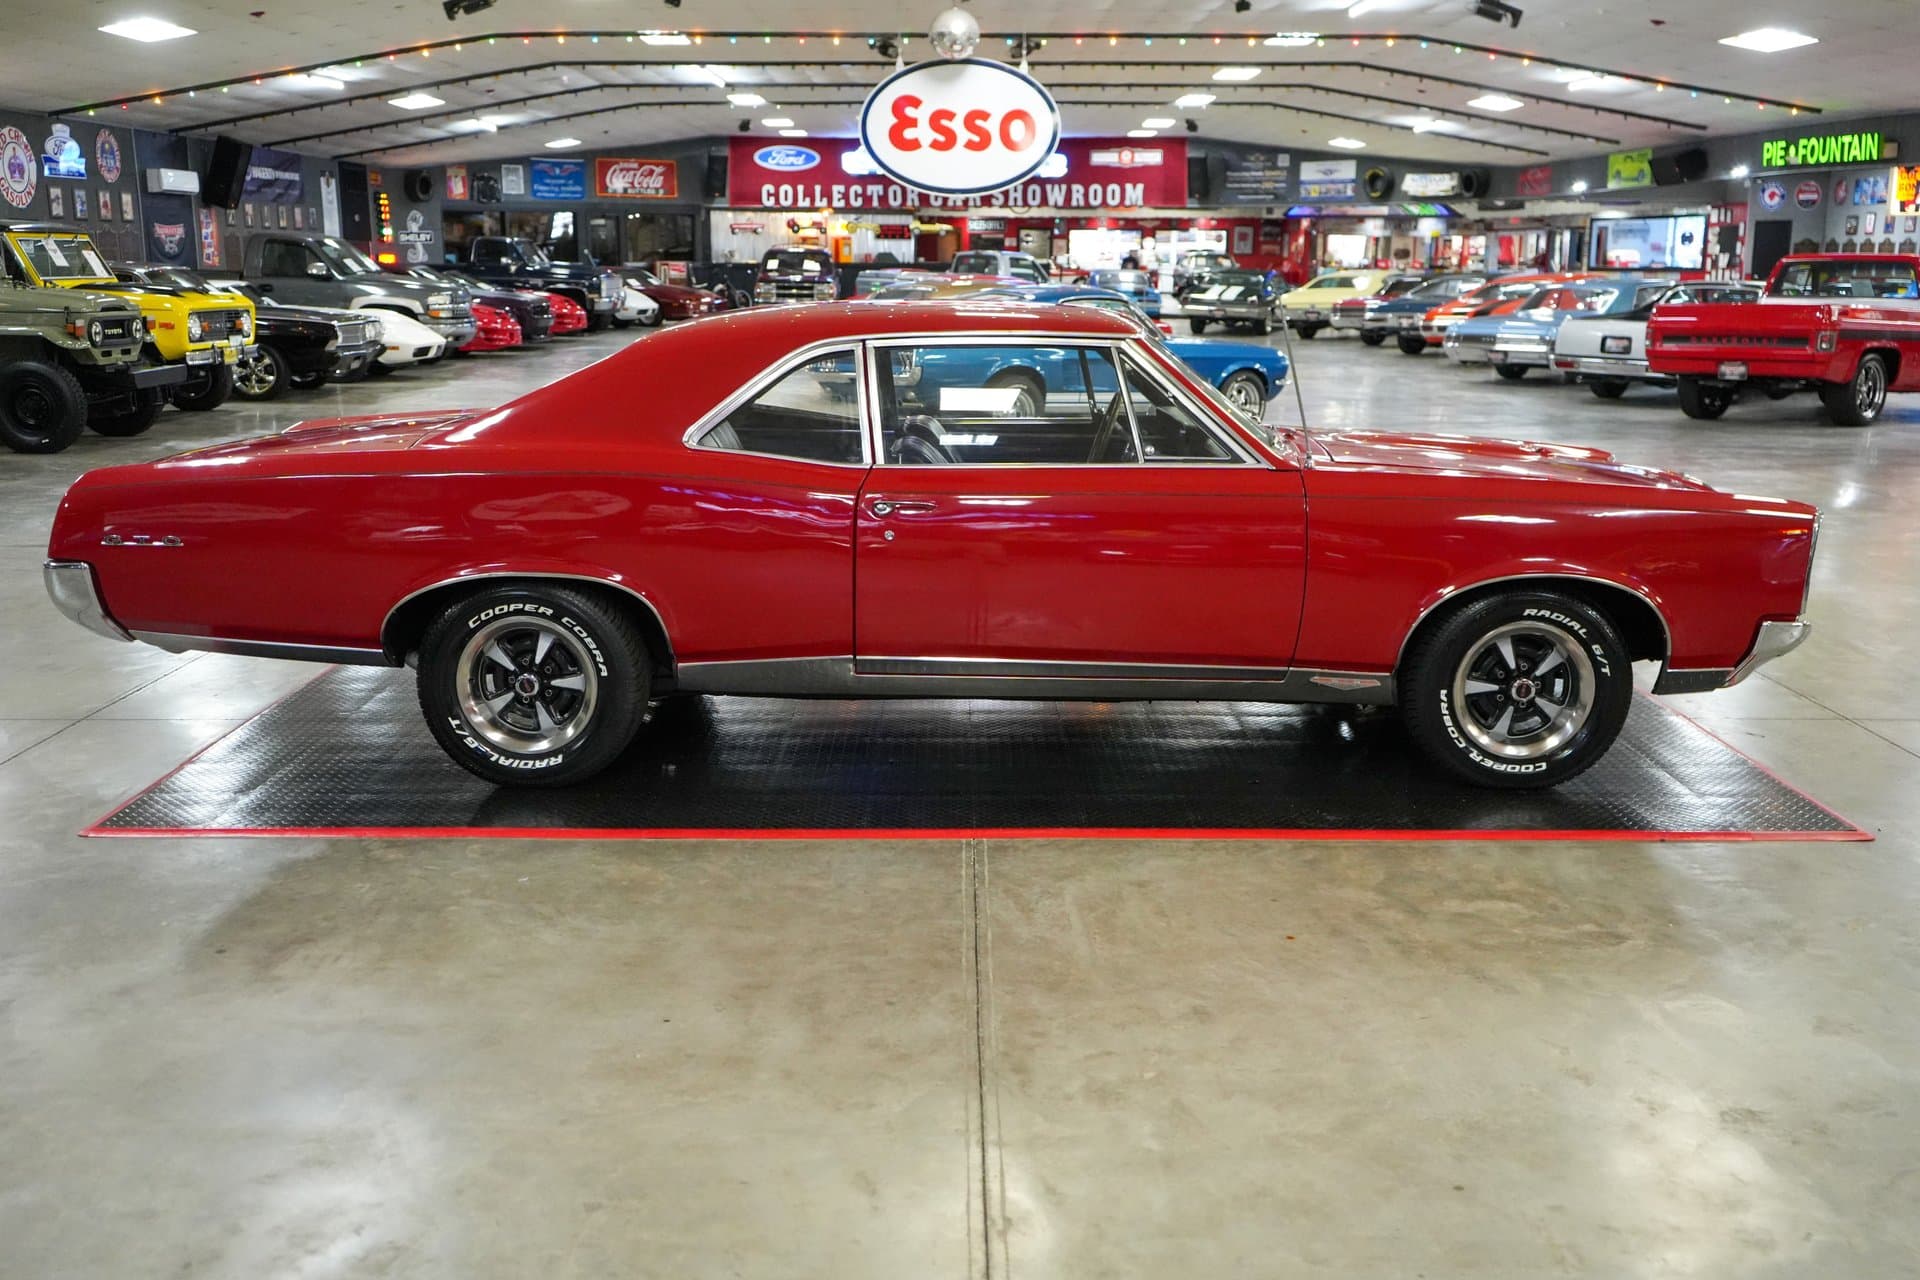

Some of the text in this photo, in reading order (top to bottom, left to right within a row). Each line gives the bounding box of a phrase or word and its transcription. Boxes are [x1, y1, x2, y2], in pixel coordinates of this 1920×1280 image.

[766, 150, 807, 166] Ford
[1762, 132, 1879, 168] PIE FOUNTAIN
[0, 177, 36, 207] GASOLINE
[761, 183, 919, 208] COLLECTOR
[991, 183, 1145, 208] SHOWROOM
[468, 603, 609, 678] COOPER COBRA
[1522, 608, 1611, 677] RADIAL G/T
[447, 716, 564, 769] RADIAL G/T
[1440, 689, 1547, 773] COOPER COBRA
